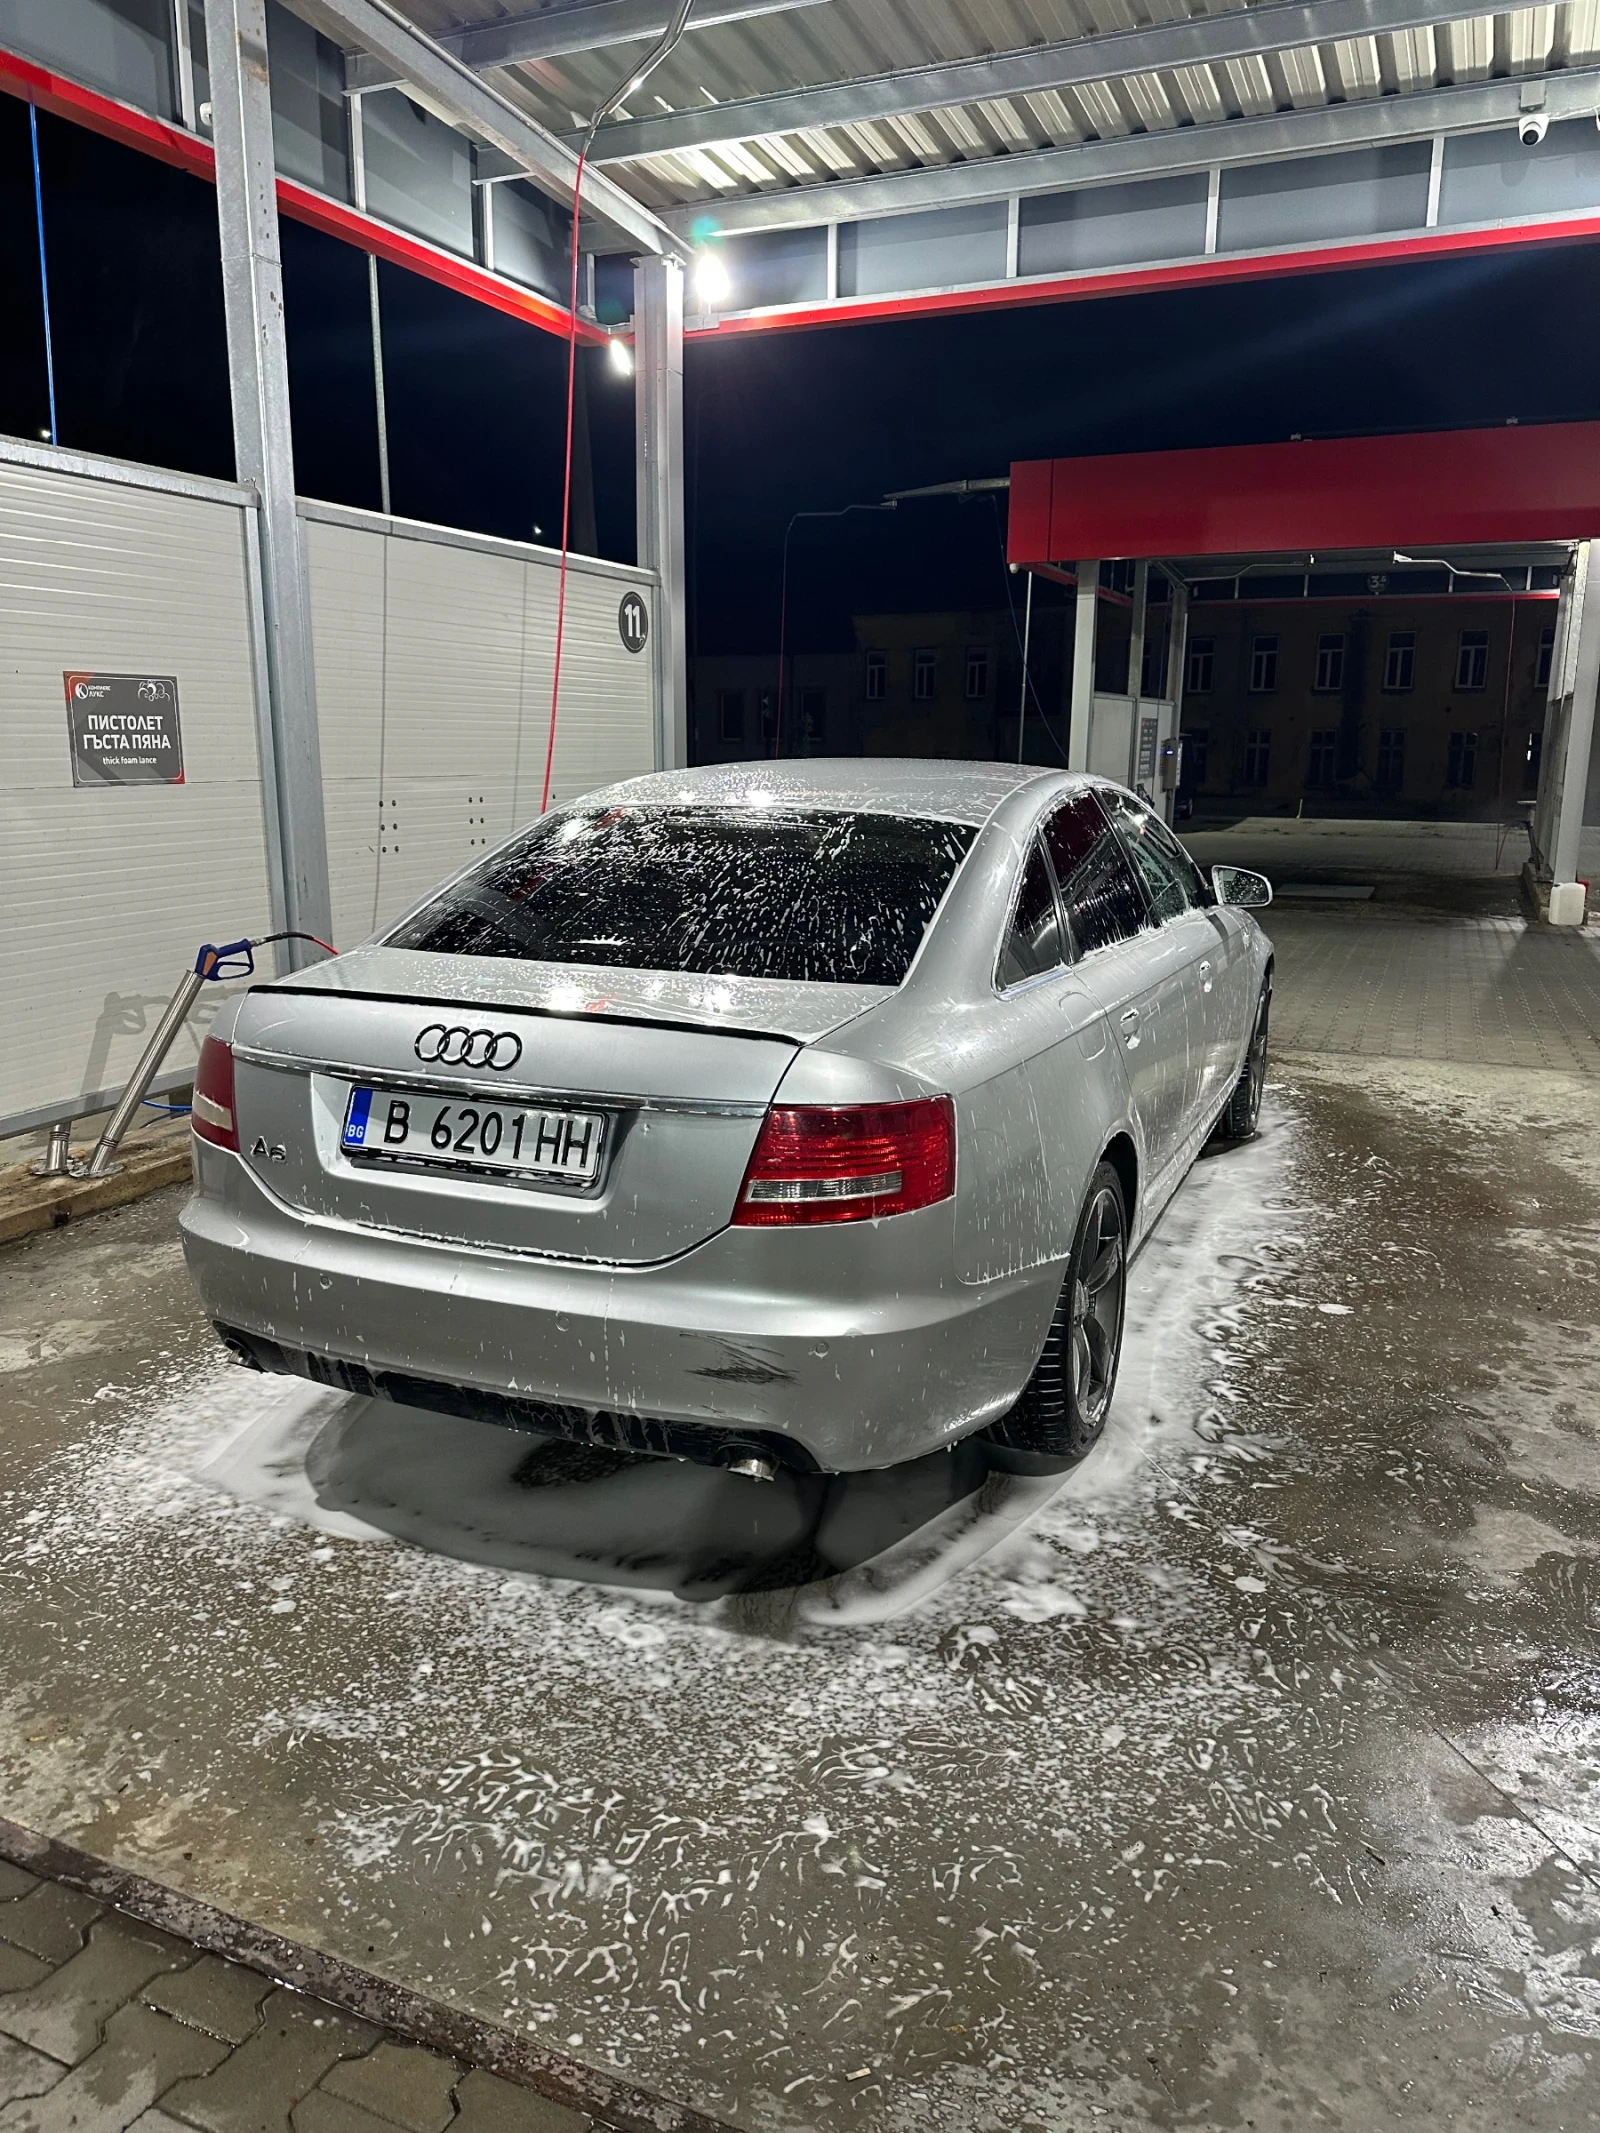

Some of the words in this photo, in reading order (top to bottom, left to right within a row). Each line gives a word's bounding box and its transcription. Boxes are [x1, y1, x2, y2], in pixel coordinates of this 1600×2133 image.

[624, 603, 641, 638] 11
[88, 715, 164, 730] ПИСТОЛЕТ
[83, 734, 131, 749] ГЪСТА
[131, 734, 172, 749] ПЯНА
[102, 757, 120, 765] thick
[120, 757, 138, 765] foam
[138, 756, 157, 764] lance
[383, 1099, 411, 1144] B
[347, 1124, 364, 1138] BG
